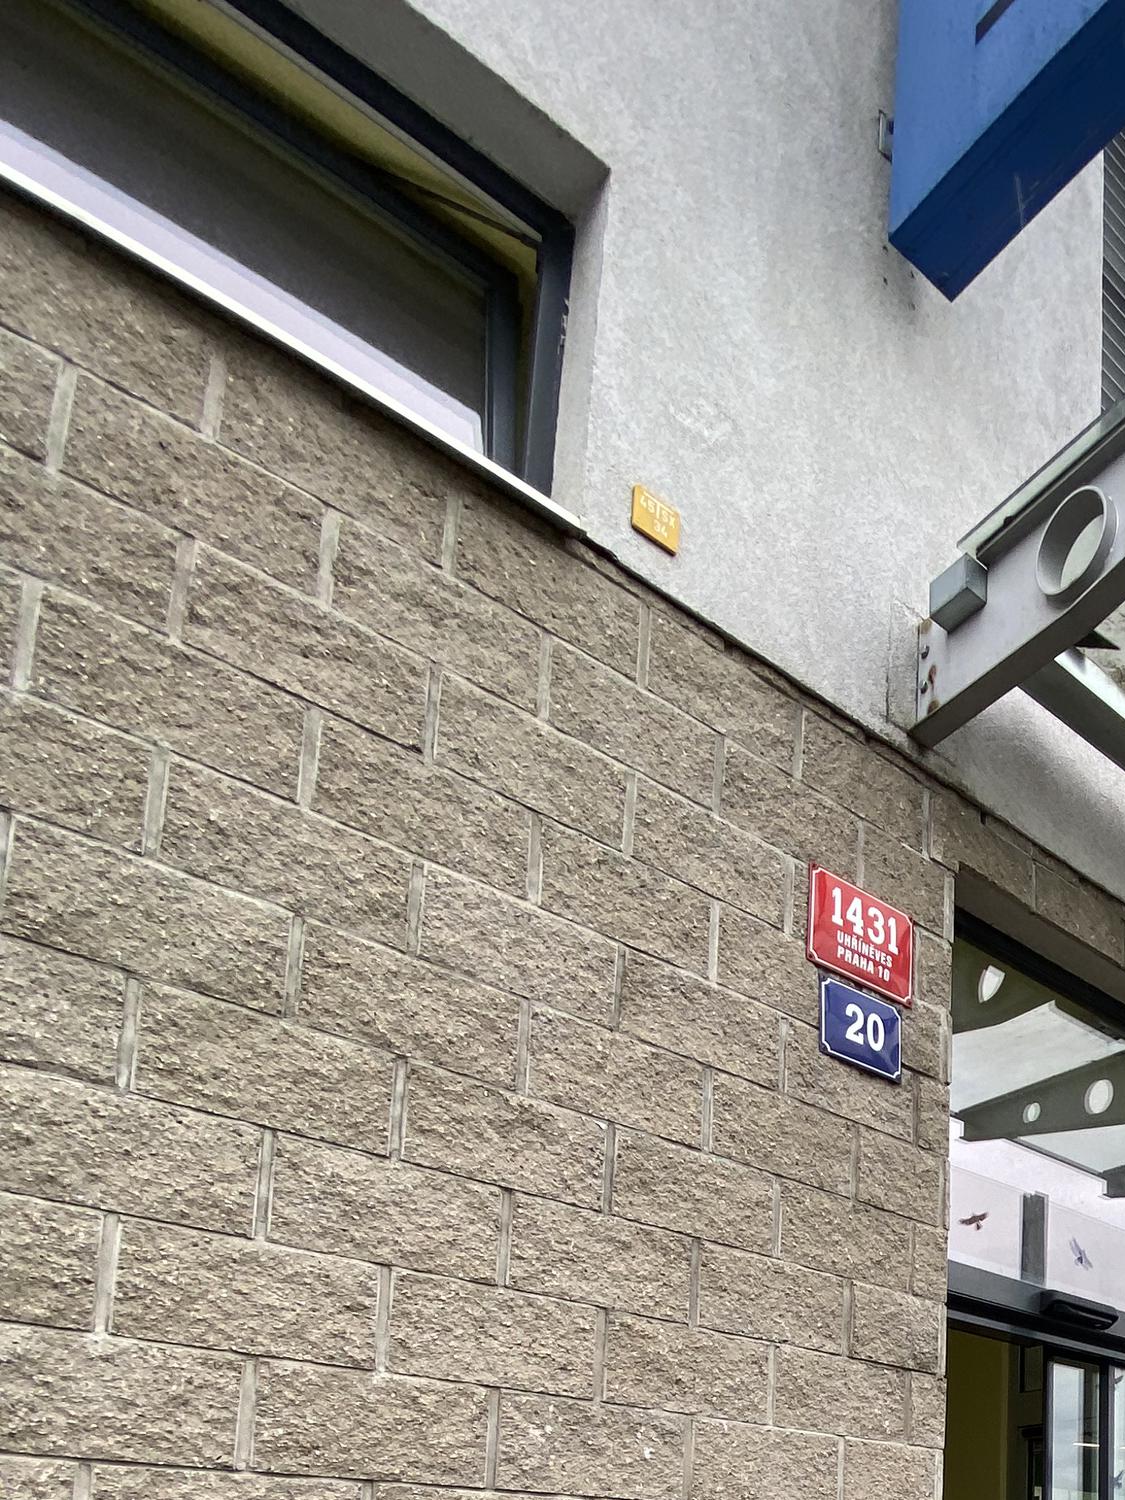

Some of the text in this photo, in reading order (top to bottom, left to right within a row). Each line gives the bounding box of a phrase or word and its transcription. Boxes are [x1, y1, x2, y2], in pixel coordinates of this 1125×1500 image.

[831, 886, 899, 956] 1431
[837, 930, 893, 968] UHŘÍNĚVES
[837, 945, 890, 982] PRAHA 10
[845, 1003, 886, 1052] 20
